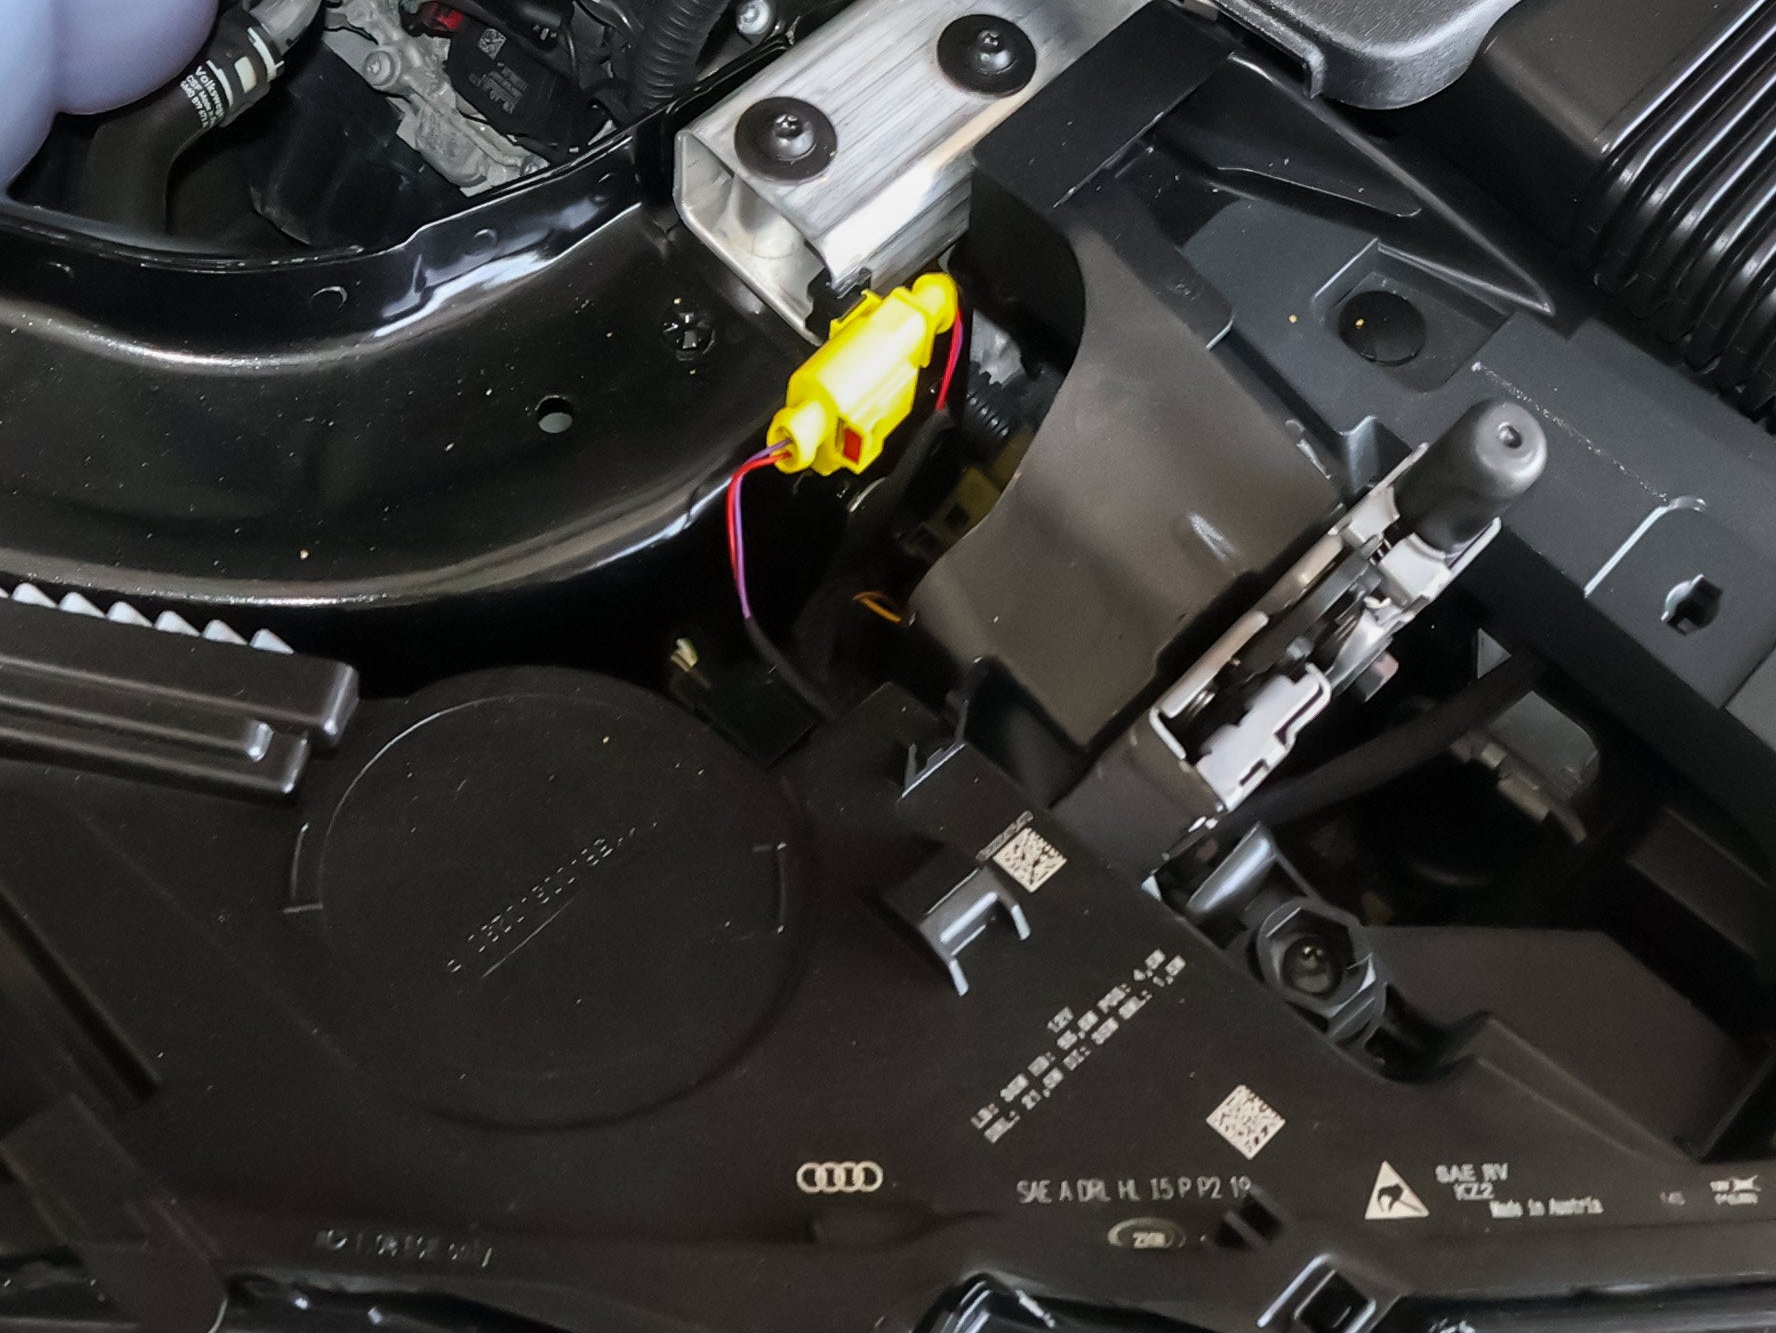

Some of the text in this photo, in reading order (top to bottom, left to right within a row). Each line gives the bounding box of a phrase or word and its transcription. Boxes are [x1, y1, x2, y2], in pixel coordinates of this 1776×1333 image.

[1435, 1163, 1476, 1183] SAE
[1059, 1179, 1074, 1202] A
[1177, 1176, 1192, 1198] P
[1196, 1175, 1223, 1200] P2
